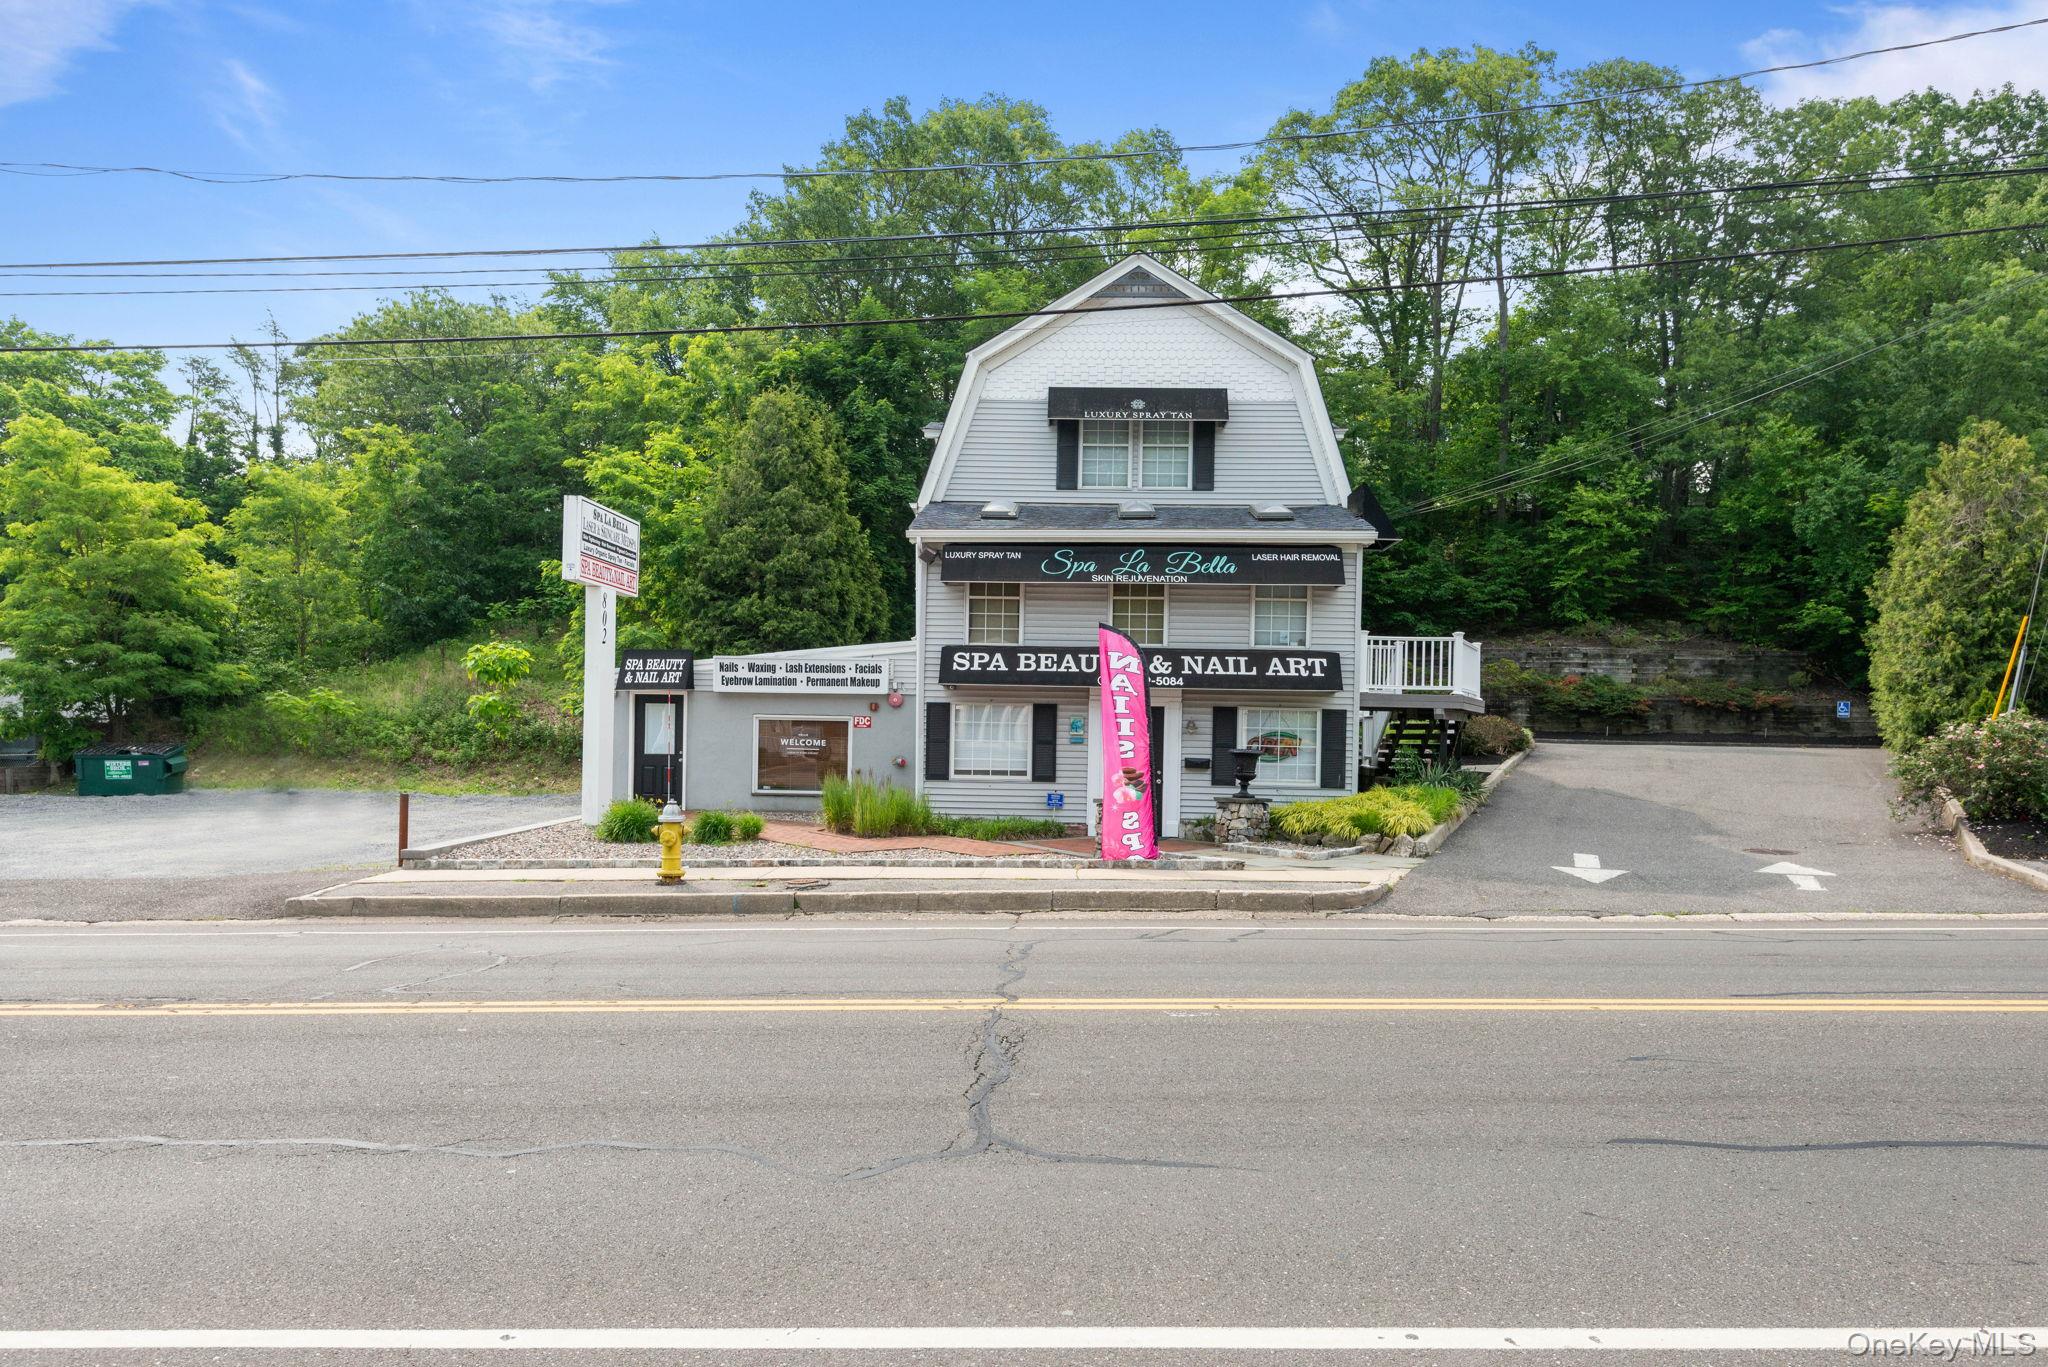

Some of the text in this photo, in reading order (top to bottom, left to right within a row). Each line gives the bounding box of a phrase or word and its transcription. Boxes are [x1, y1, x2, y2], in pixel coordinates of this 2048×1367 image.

[1132, 411, 1168, 419] SPRAY
[1041, 549, 1237, 579] Spa La Bella
[1091, 574, 1188, 583] SKIN REJUVENATION
[625, 658, 686, 670] SPA BEAUTY
[719, 662, 739, 673] Nails
[747, 662, 776, 674] Waxing
[785, 662, 803, 673] Lash
[804, 663, 846, 674] Extensions
[855, 663, 882, 674] Facials
[952, 652, 1327, 677] SPA BEAU & NAIL ART
[624, 671, 682, 683] & NAIL ART
[721, 675, 880, 688] Eyebrow Lamination Permanent Makeup
[854, 716, 871, 725] FDC
[780, 738, 827, 747] WELCOME
